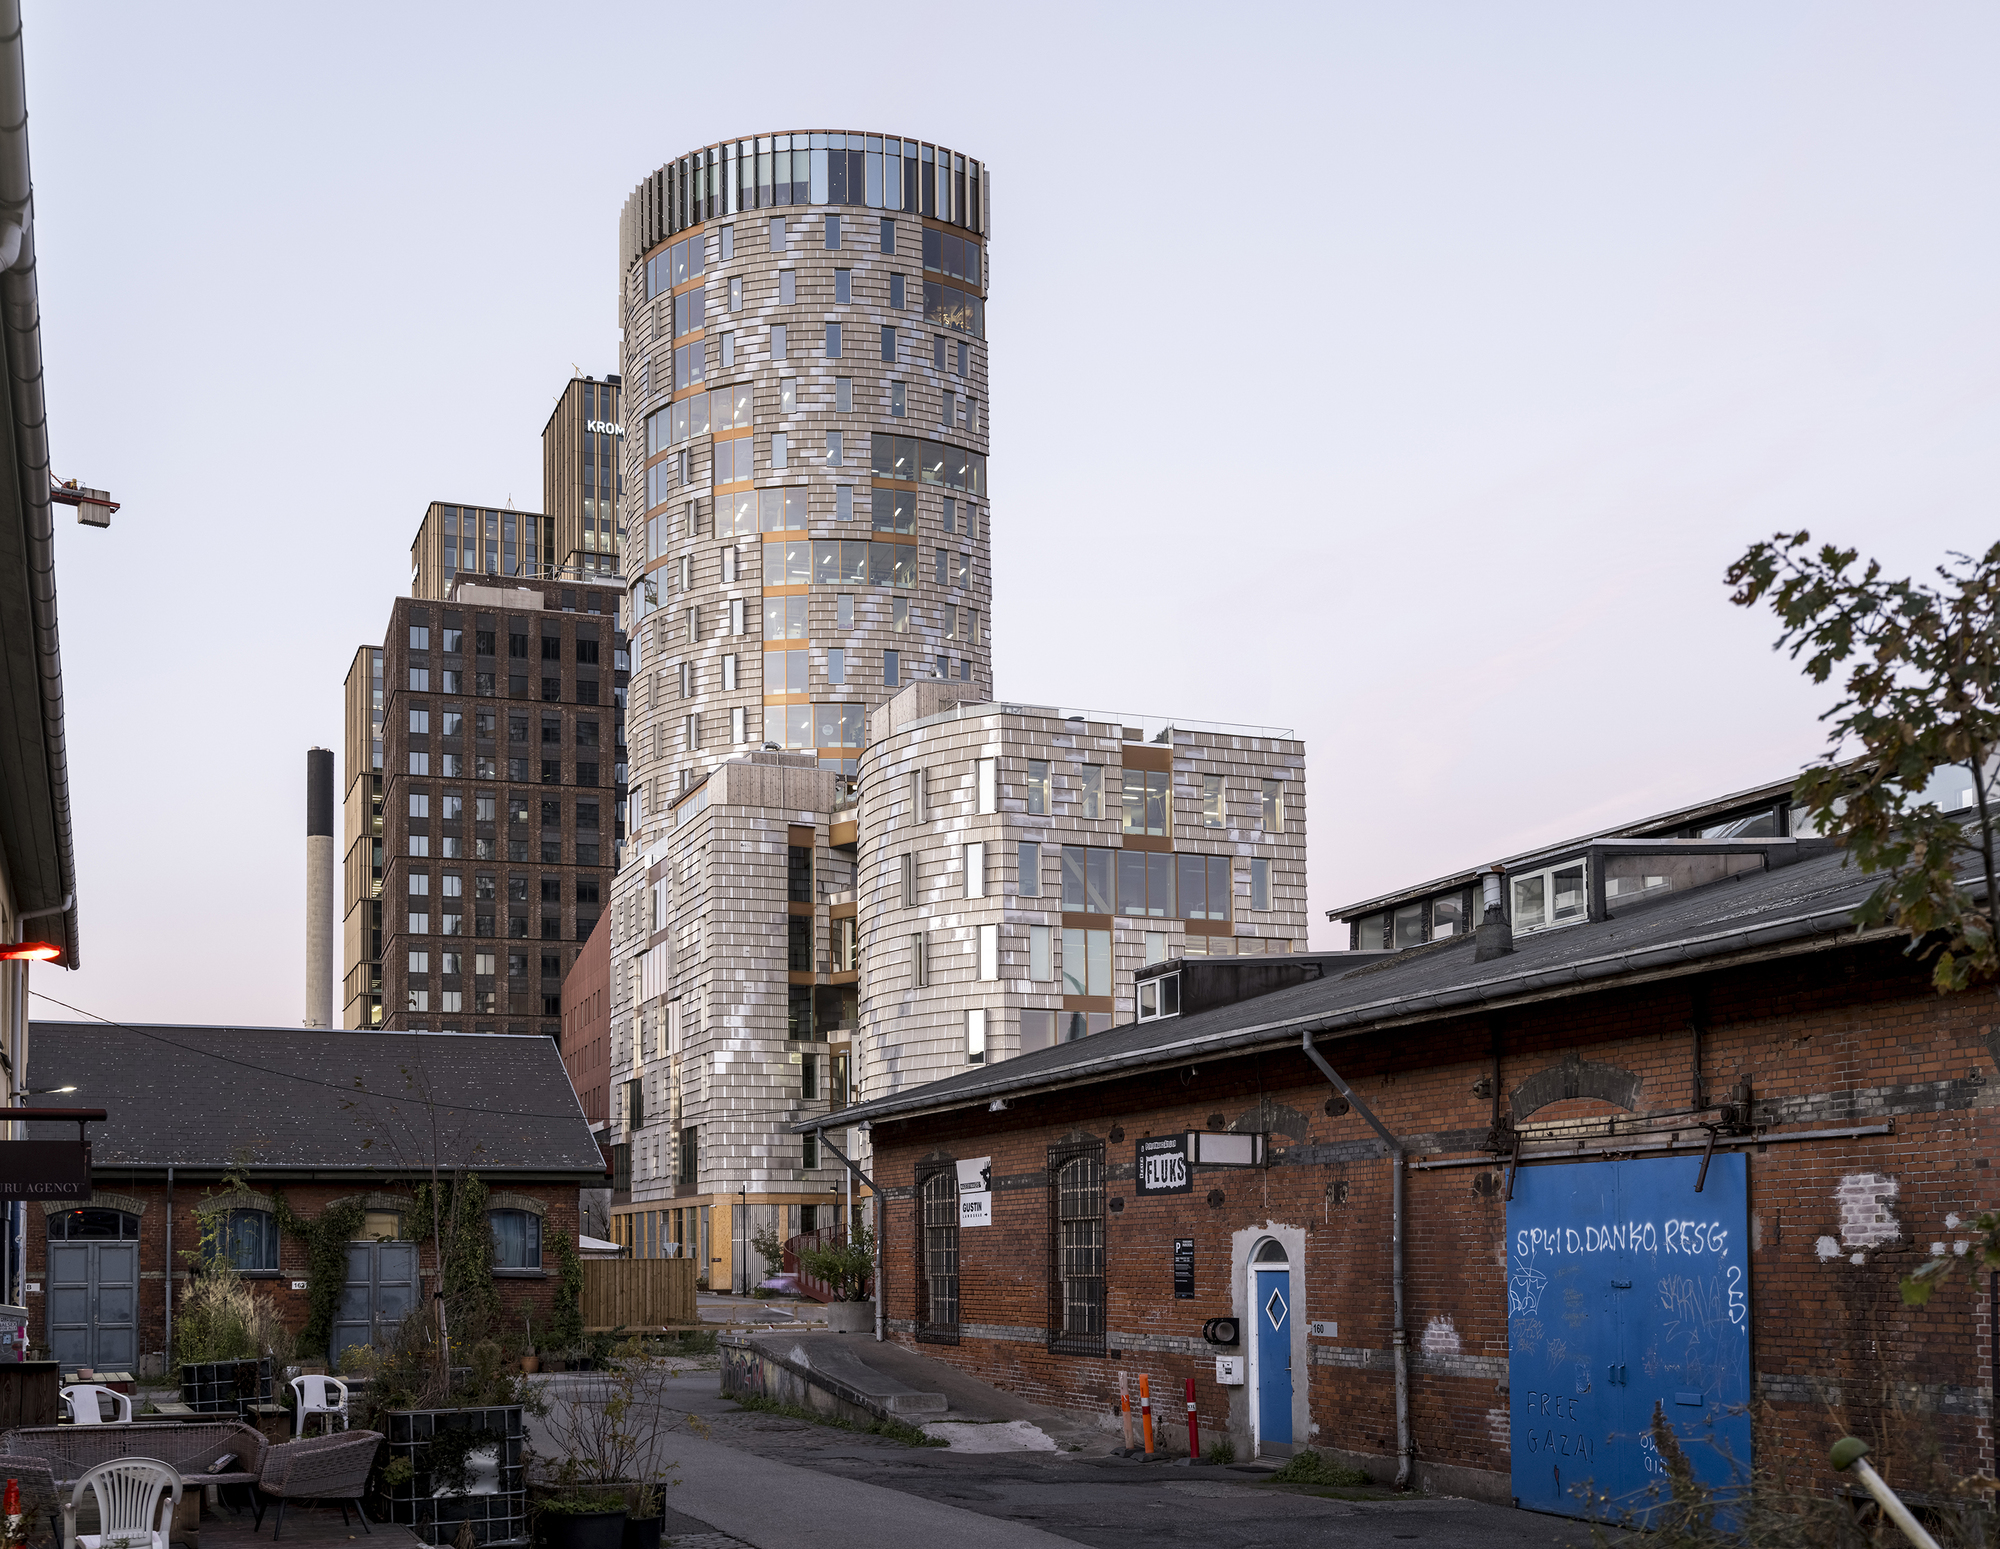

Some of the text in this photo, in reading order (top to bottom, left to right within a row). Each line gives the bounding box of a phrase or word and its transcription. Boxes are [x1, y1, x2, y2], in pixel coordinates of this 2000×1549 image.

[1146, 1156, 1185, 1184] FLUKS
[962, 1202, 983, 1213] GUSTIN
[1313, 1323, 1325, 1334] 160
[1526, 1391, 1579, 1422] FREE
[1526, 1428, 1595, 1464] GAZA!
